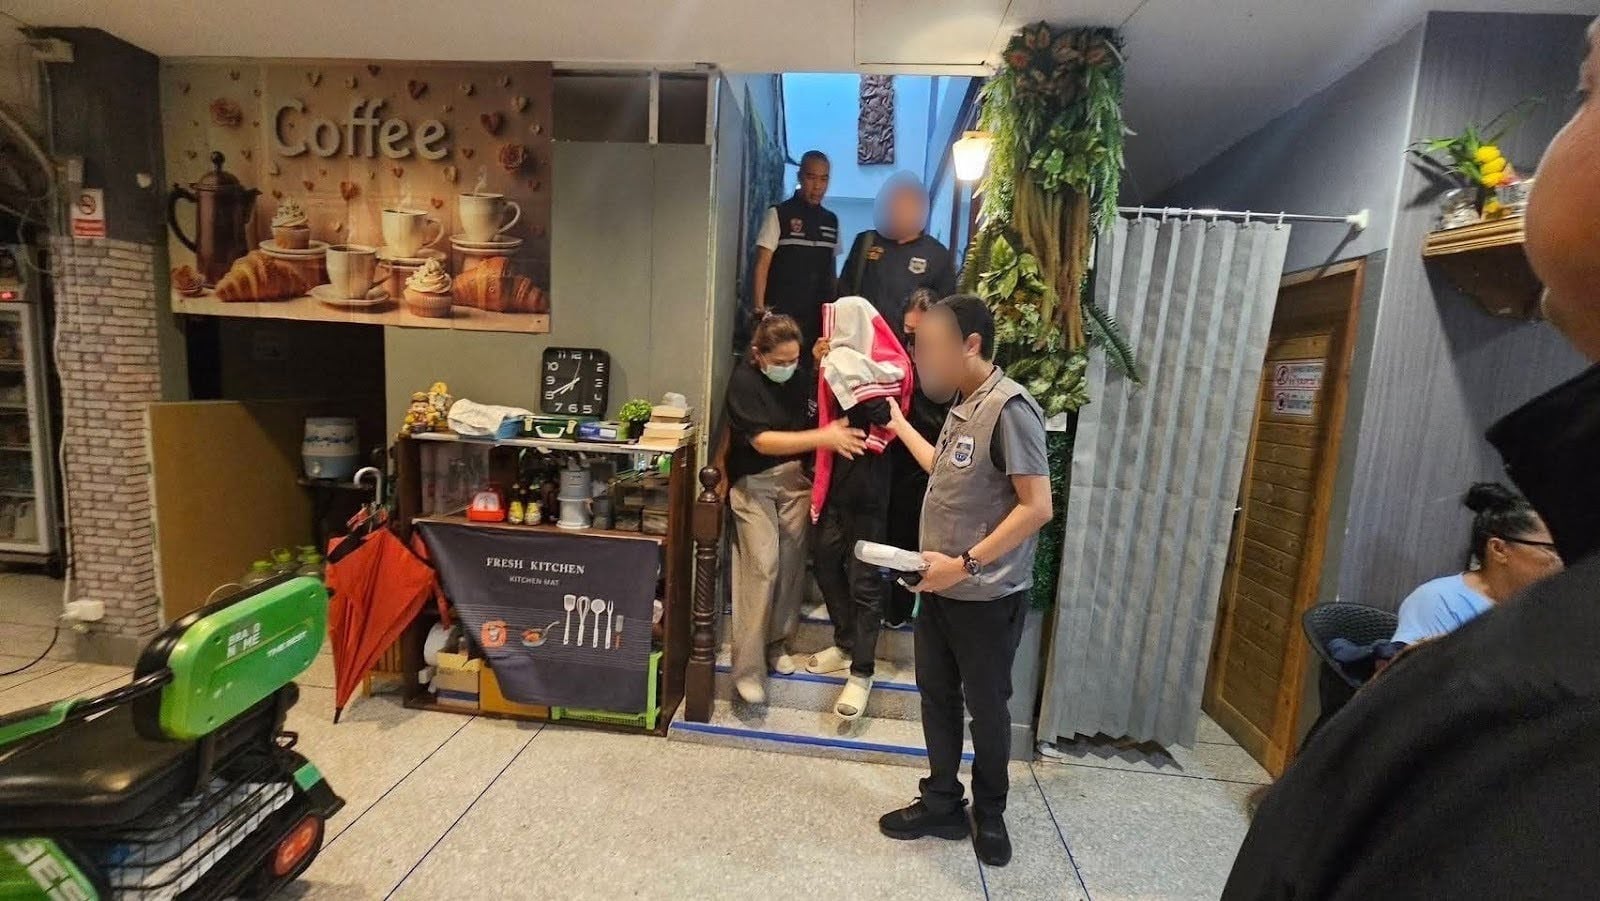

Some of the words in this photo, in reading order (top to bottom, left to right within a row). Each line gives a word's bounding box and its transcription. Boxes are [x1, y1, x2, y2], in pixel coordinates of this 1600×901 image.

[274, 98, 449, 160] Coffee
[547, 362, 559, 371] 10
[596, 362, 604, 373] 2
[545, 376, 555, 385] 9
[594, 378, 604, 388] 3
[544, 390, 555, 400] 8
[554, 402, 563, 412] 7
[568, 403, 579, 413] 6
[582, 404, 593, 414] 5
[486, 558, 523, 569] FRESH
[530, 561, 585, 574] KITCHEN
[509, 576, 541, 585] KITCHEN
